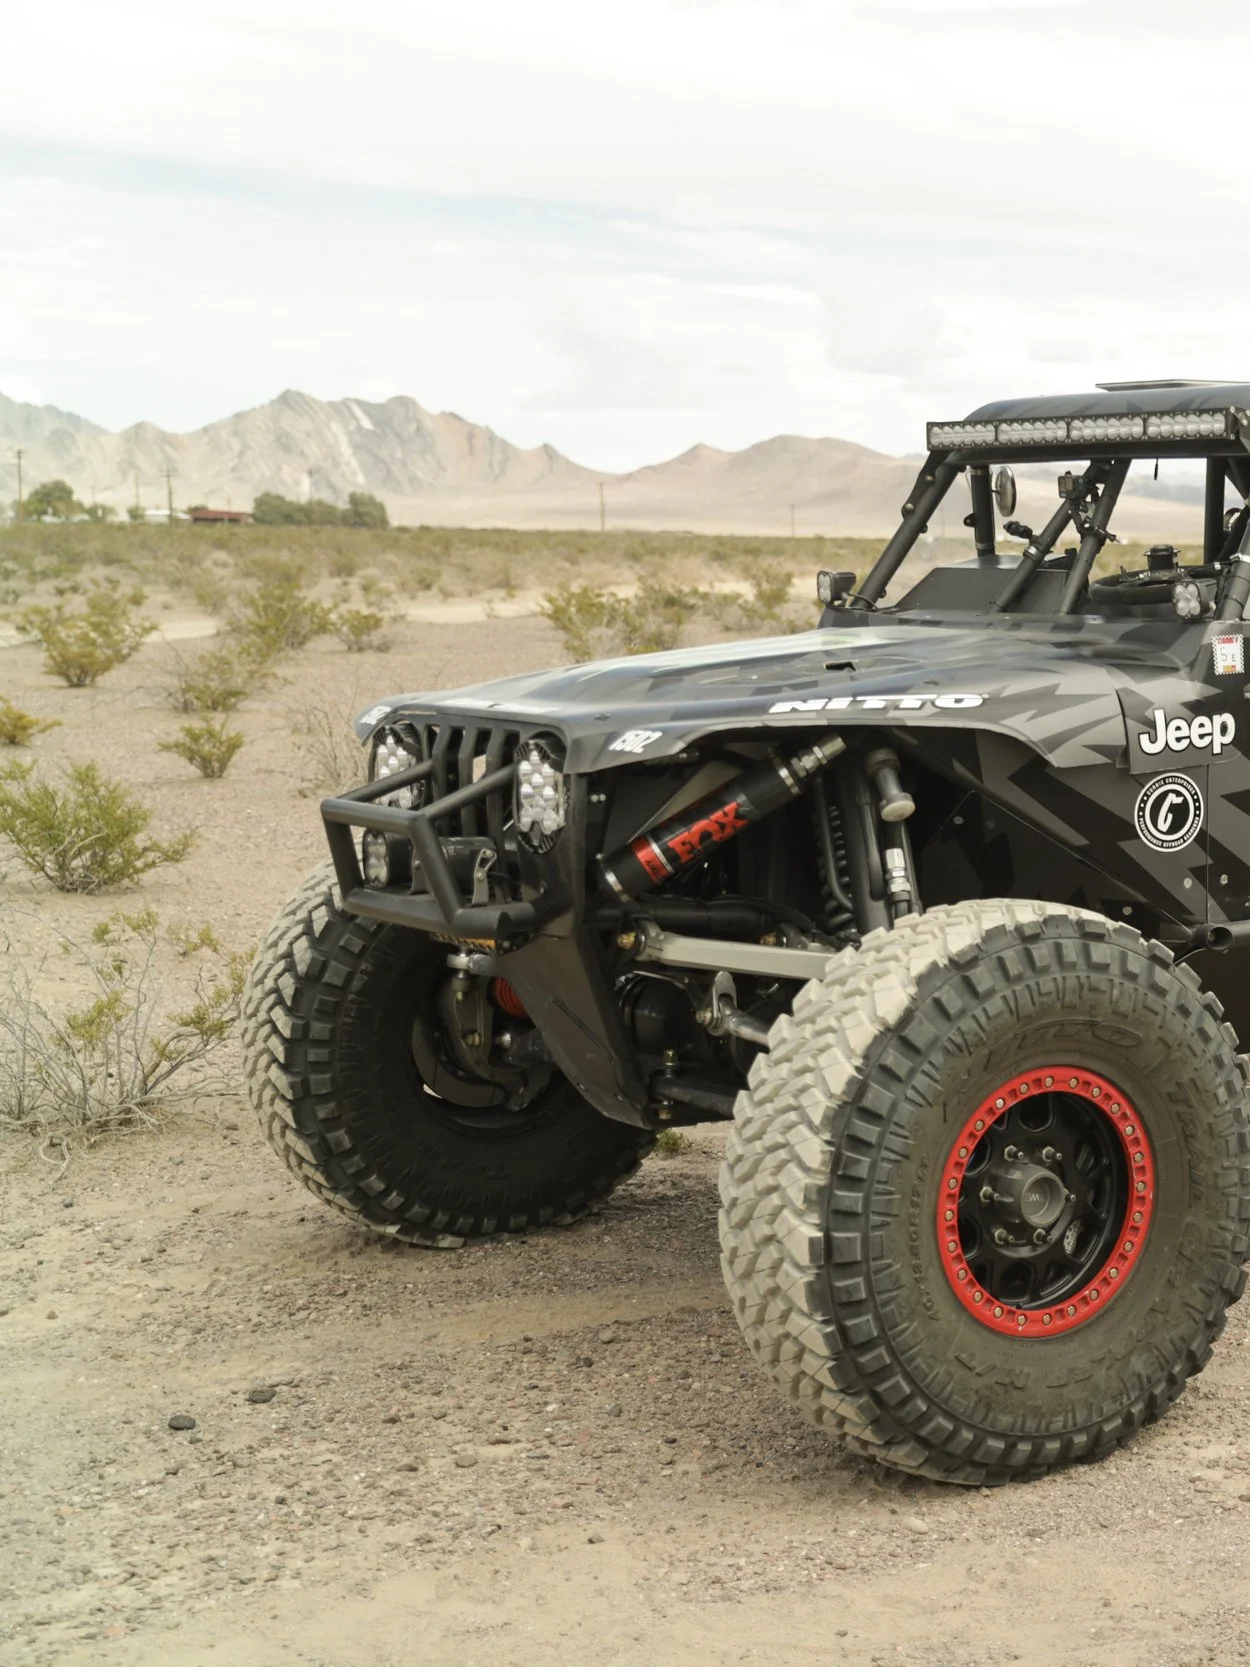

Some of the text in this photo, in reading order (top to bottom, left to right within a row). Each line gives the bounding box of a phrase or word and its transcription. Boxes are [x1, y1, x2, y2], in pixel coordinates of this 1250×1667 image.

[769, 693, 984, 714] NITTO
[608, 730, 663, 753] 1502
[1139, 708, 1236, 754] Jeep
[667, 801, 749, 864] FOX
